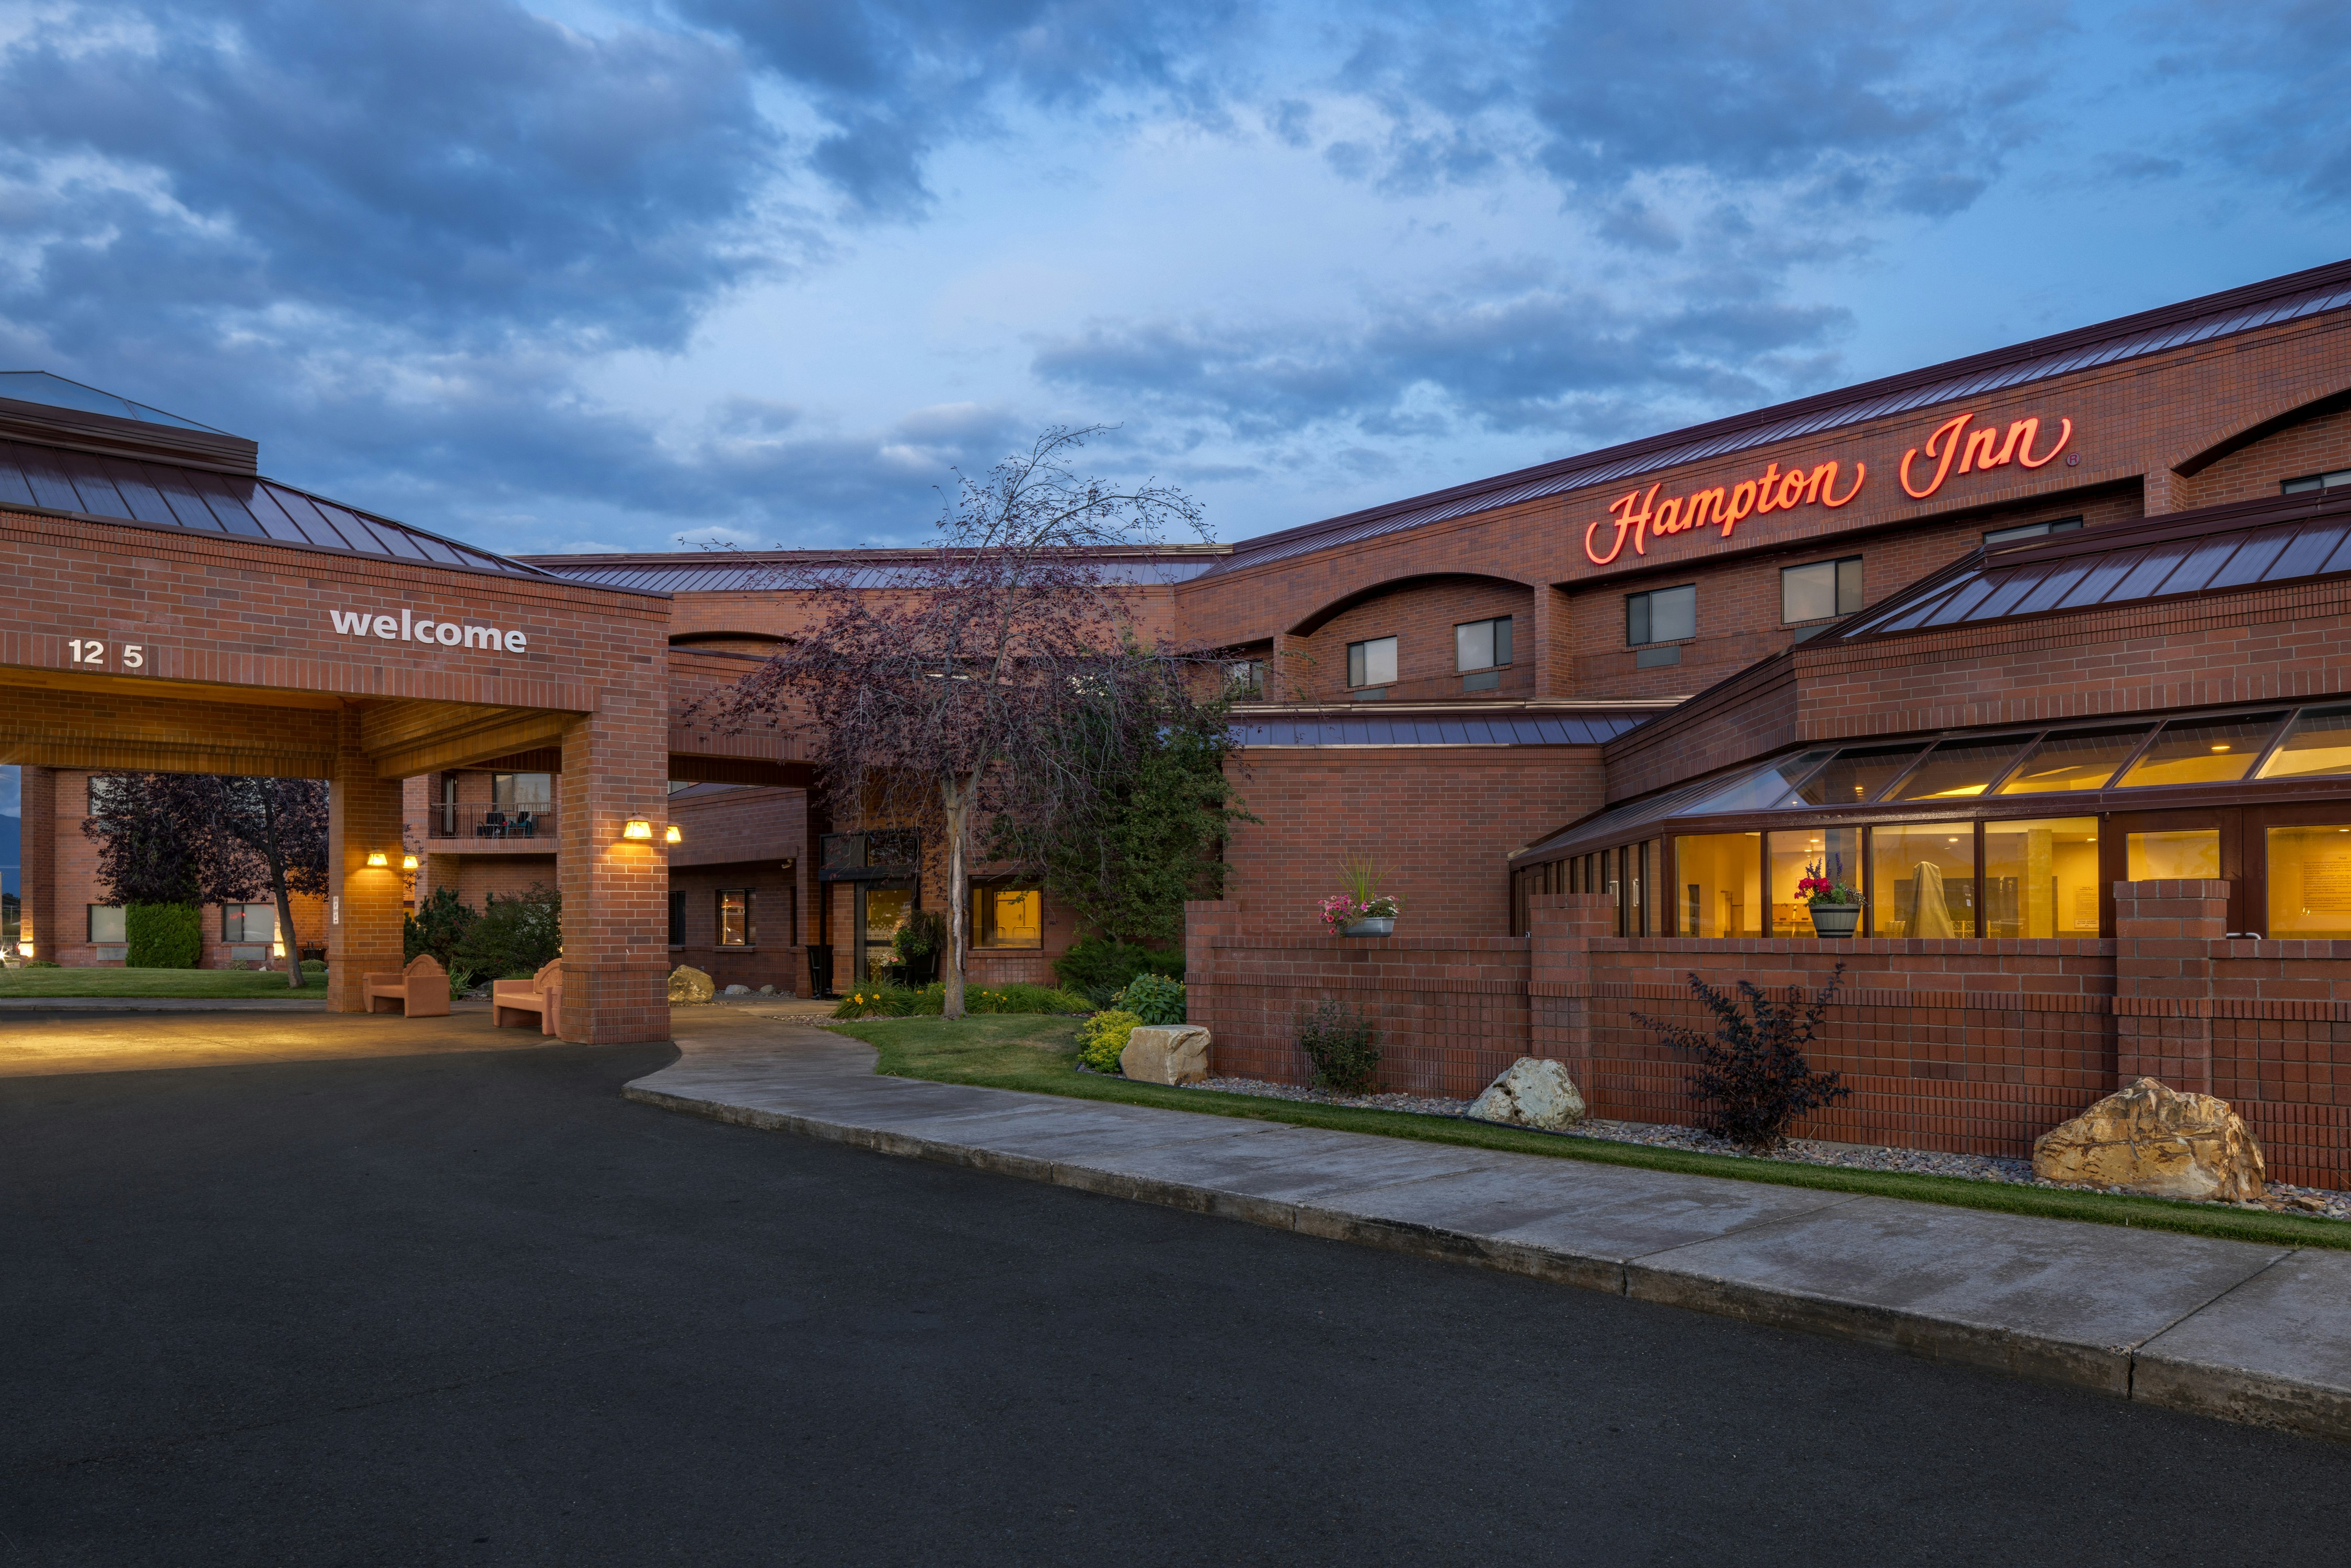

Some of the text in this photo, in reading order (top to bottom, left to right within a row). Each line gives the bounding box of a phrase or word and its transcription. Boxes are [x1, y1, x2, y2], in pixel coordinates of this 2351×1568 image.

[1585, 459, 1865, 565] Hampton
[1900, 413, 2072, 500] Inn
[329, 608, 527, 653] welcome
